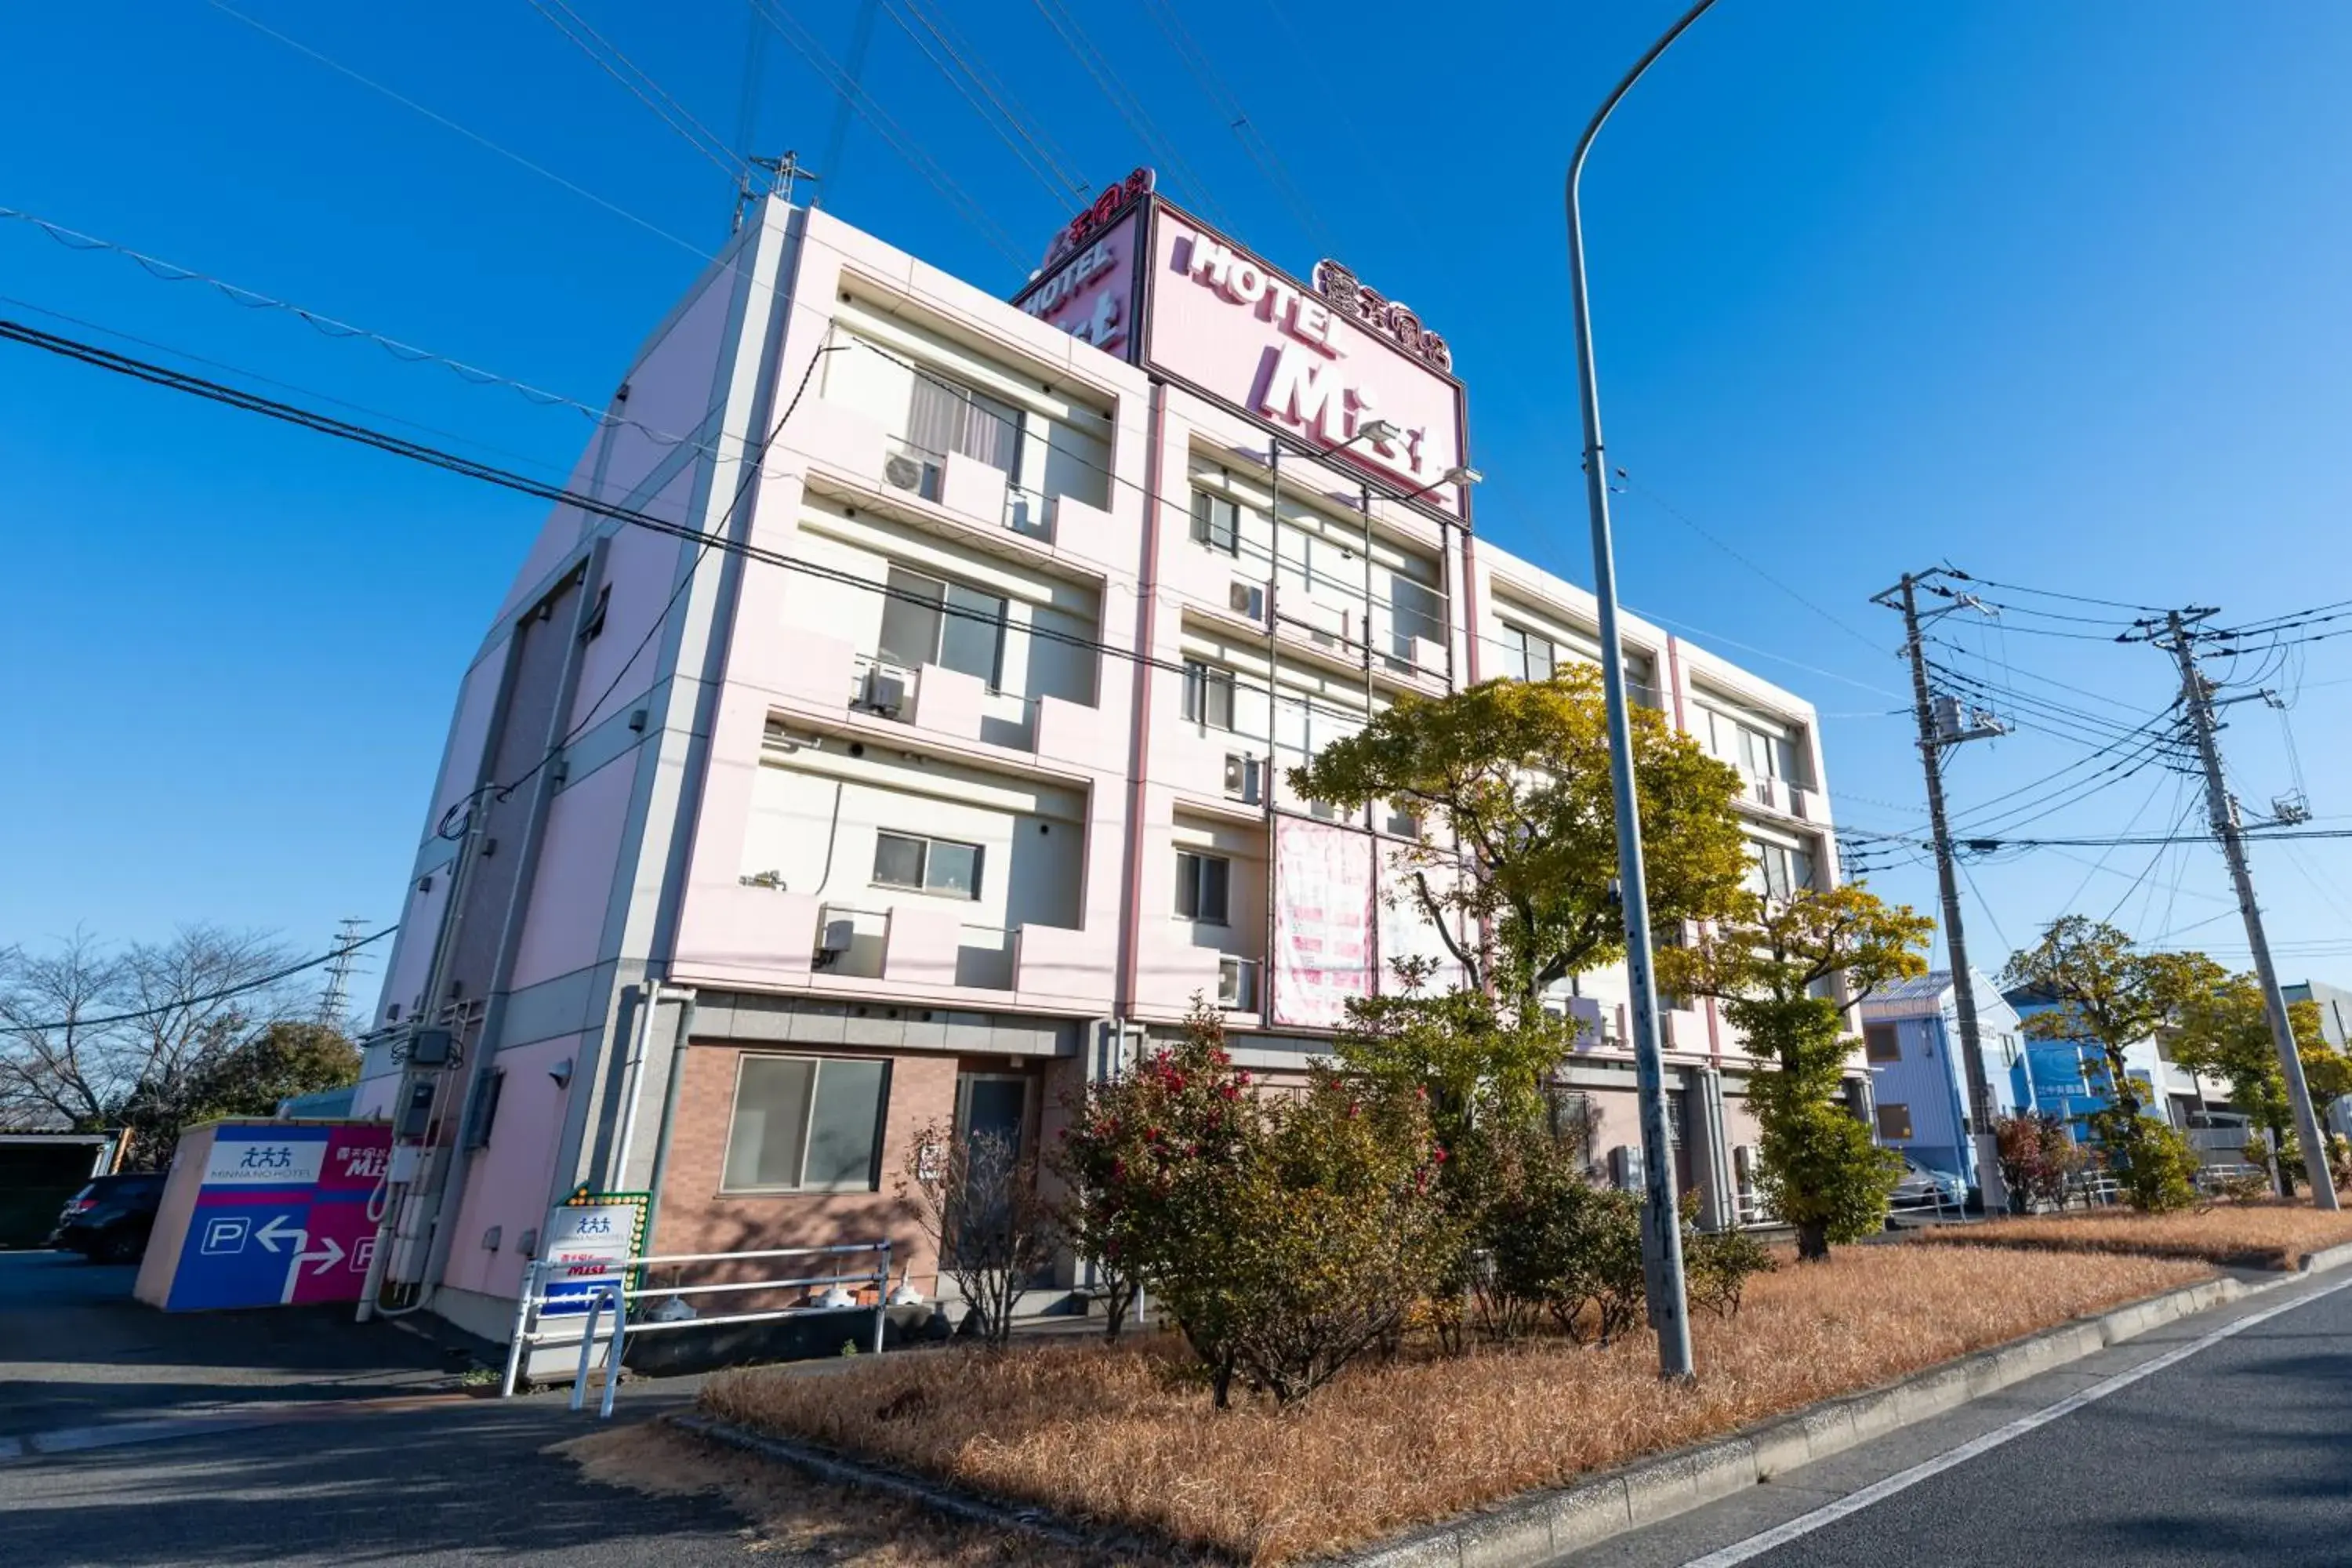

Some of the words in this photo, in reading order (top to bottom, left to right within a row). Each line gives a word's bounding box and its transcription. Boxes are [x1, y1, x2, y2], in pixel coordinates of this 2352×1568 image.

[1024, 240, 1115, 317] HOTEL
[1189, 230, 1348, 358] HOTEL
[209, 1224, 242, 1248] P
